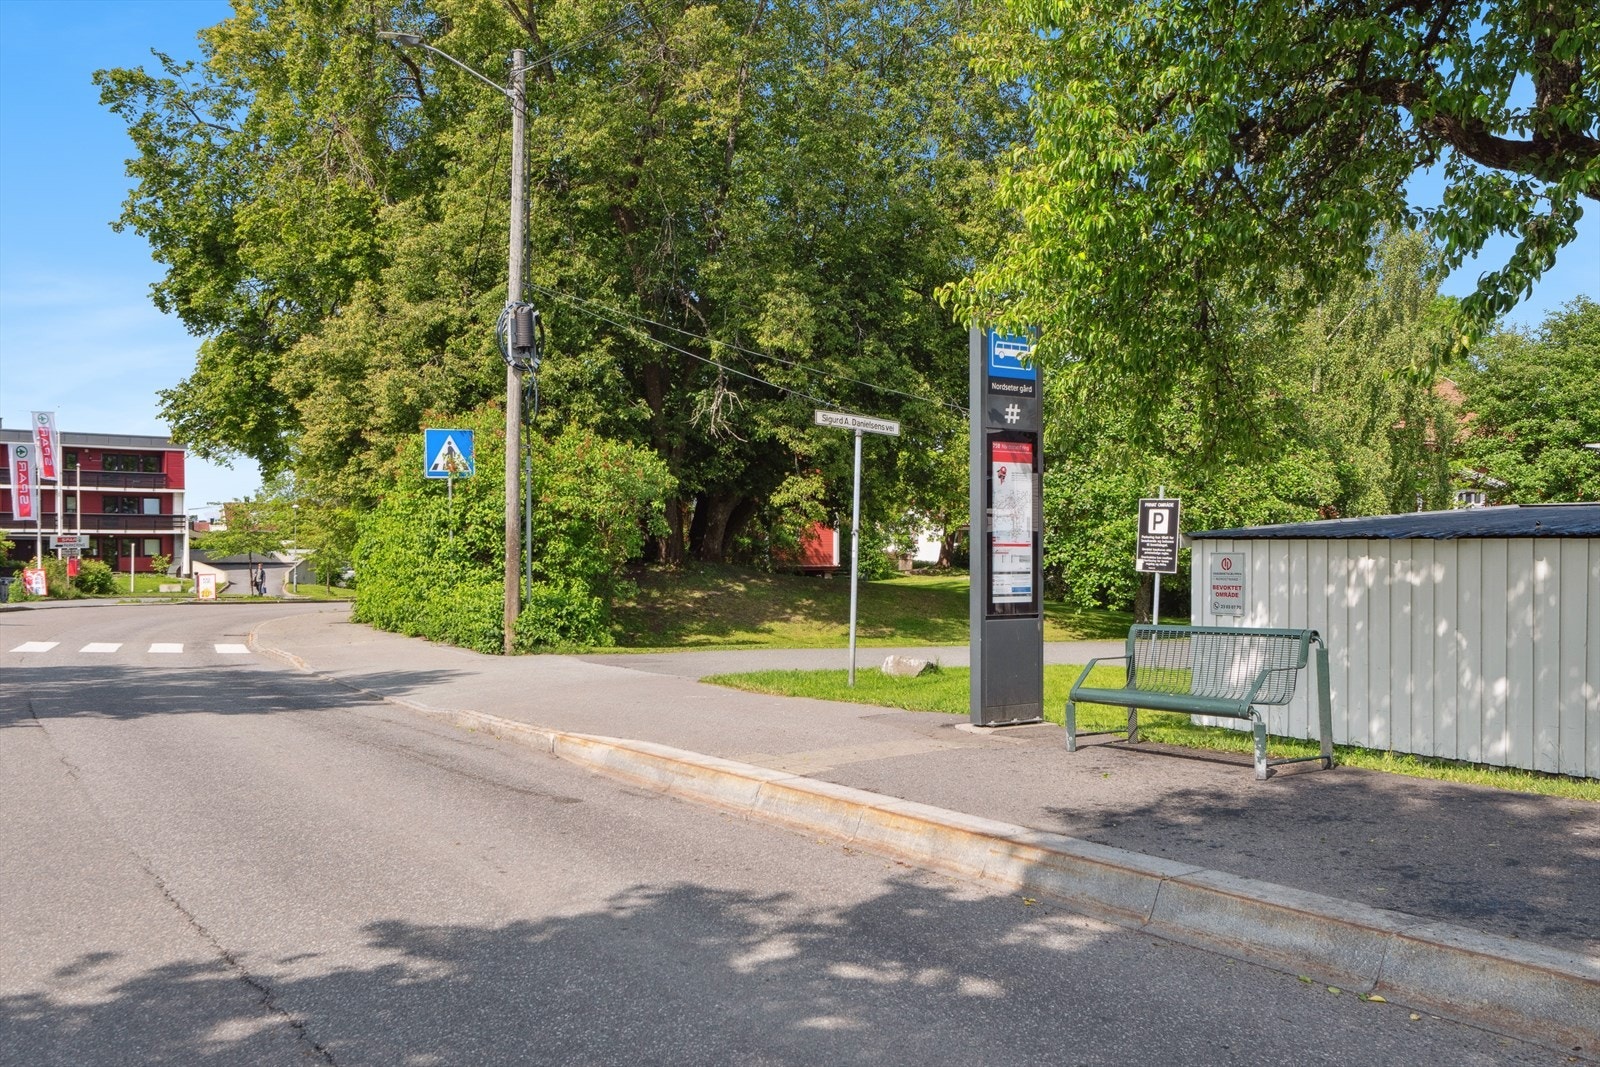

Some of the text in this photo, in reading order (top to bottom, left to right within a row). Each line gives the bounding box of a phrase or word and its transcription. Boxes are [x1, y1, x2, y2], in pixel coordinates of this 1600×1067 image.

[991, 382, 1032, 393] Nordseter gård
[822, 414, 843, 425] Sigurd
[852, 418, 885, 430] Danielsens
[1153, 512, 1164, 530] P
